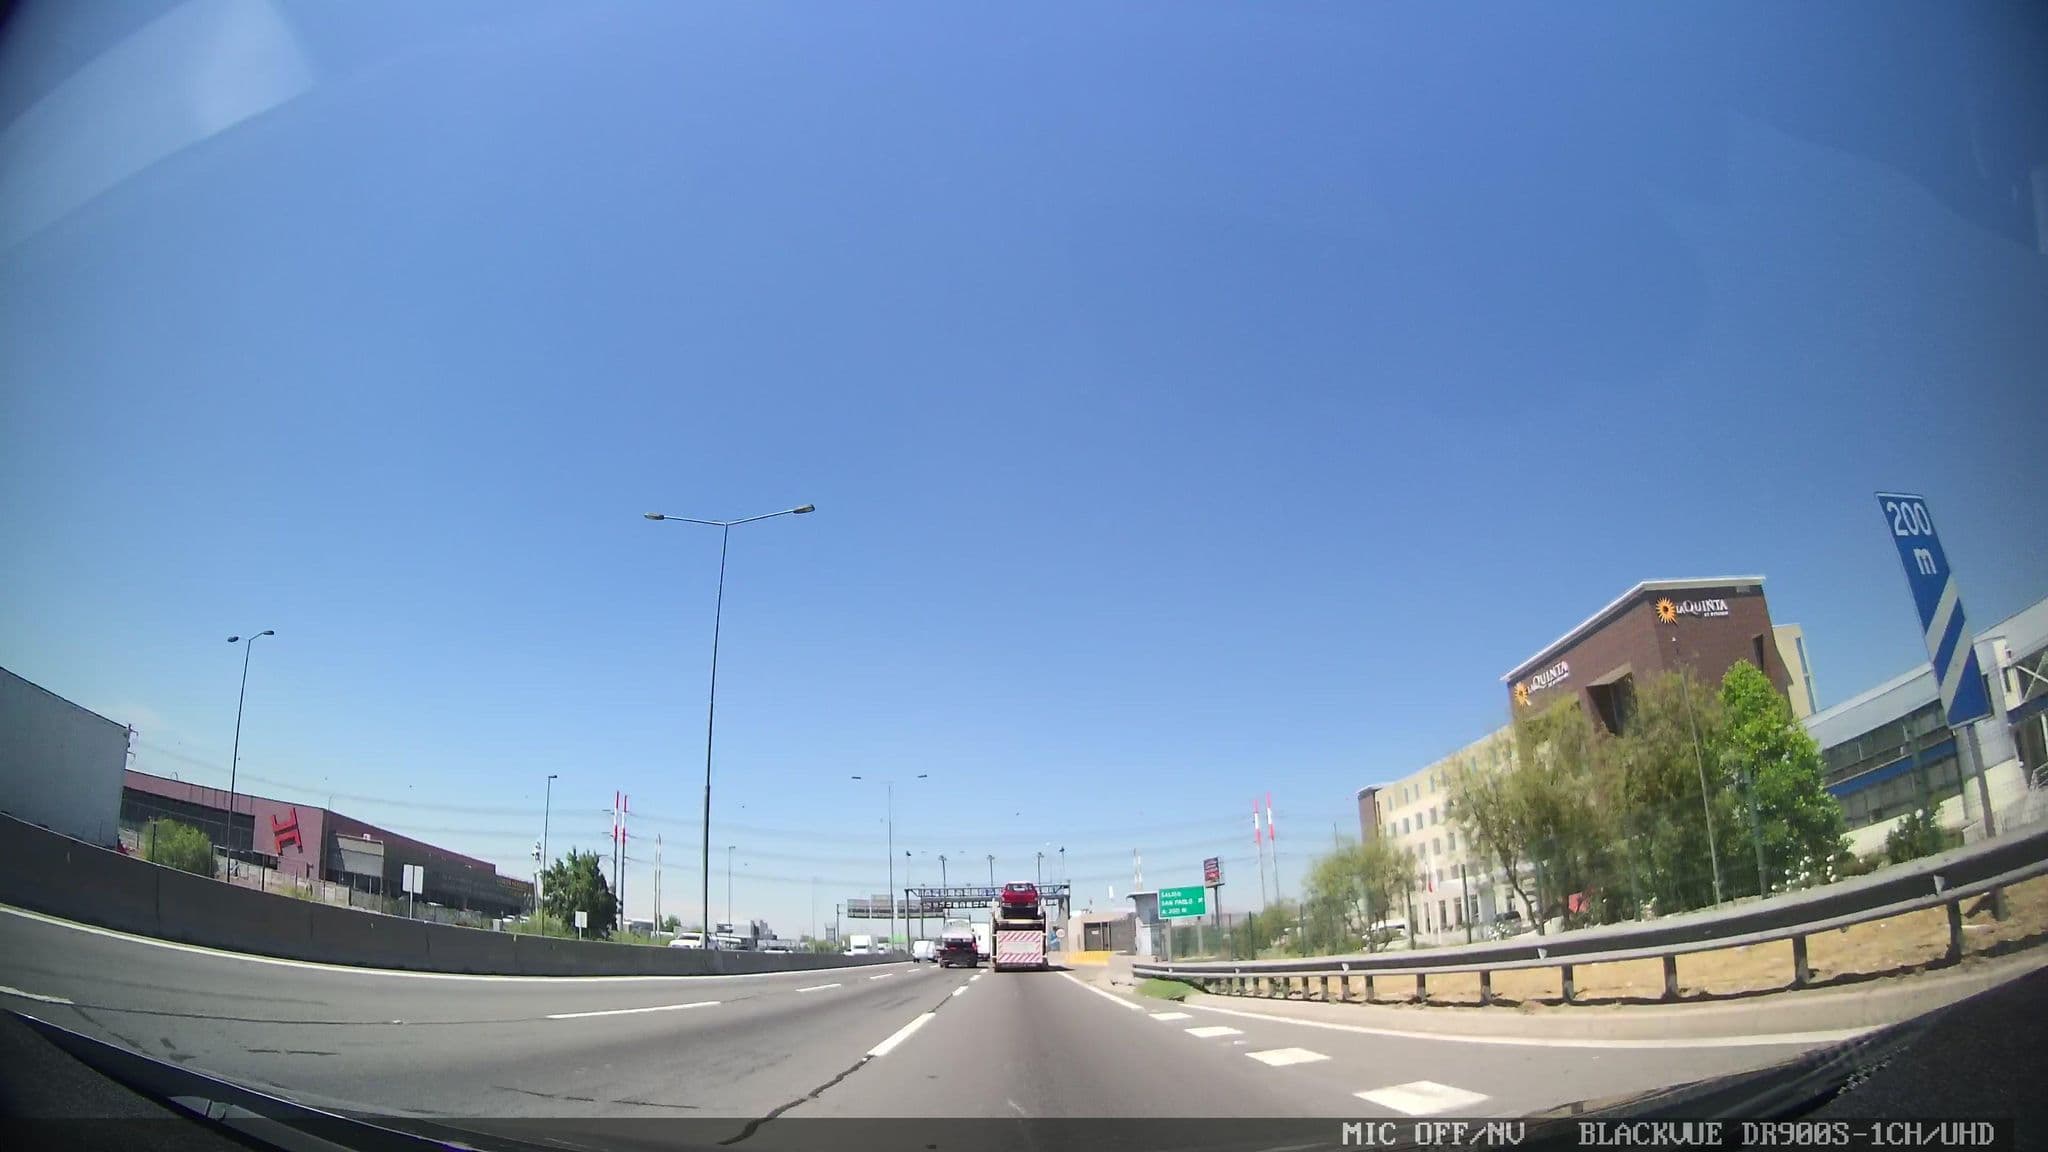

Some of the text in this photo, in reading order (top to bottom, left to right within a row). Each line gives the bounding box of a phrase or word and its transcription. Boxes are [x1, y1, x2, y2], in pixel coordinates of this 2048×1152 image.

[1886, 501, 1932, 536] 200
[1913, 548, 1937, 575] m
[1683, 599, 1729, 615] QUINTA
[1532, 661, 1569, 690] QUINTA
